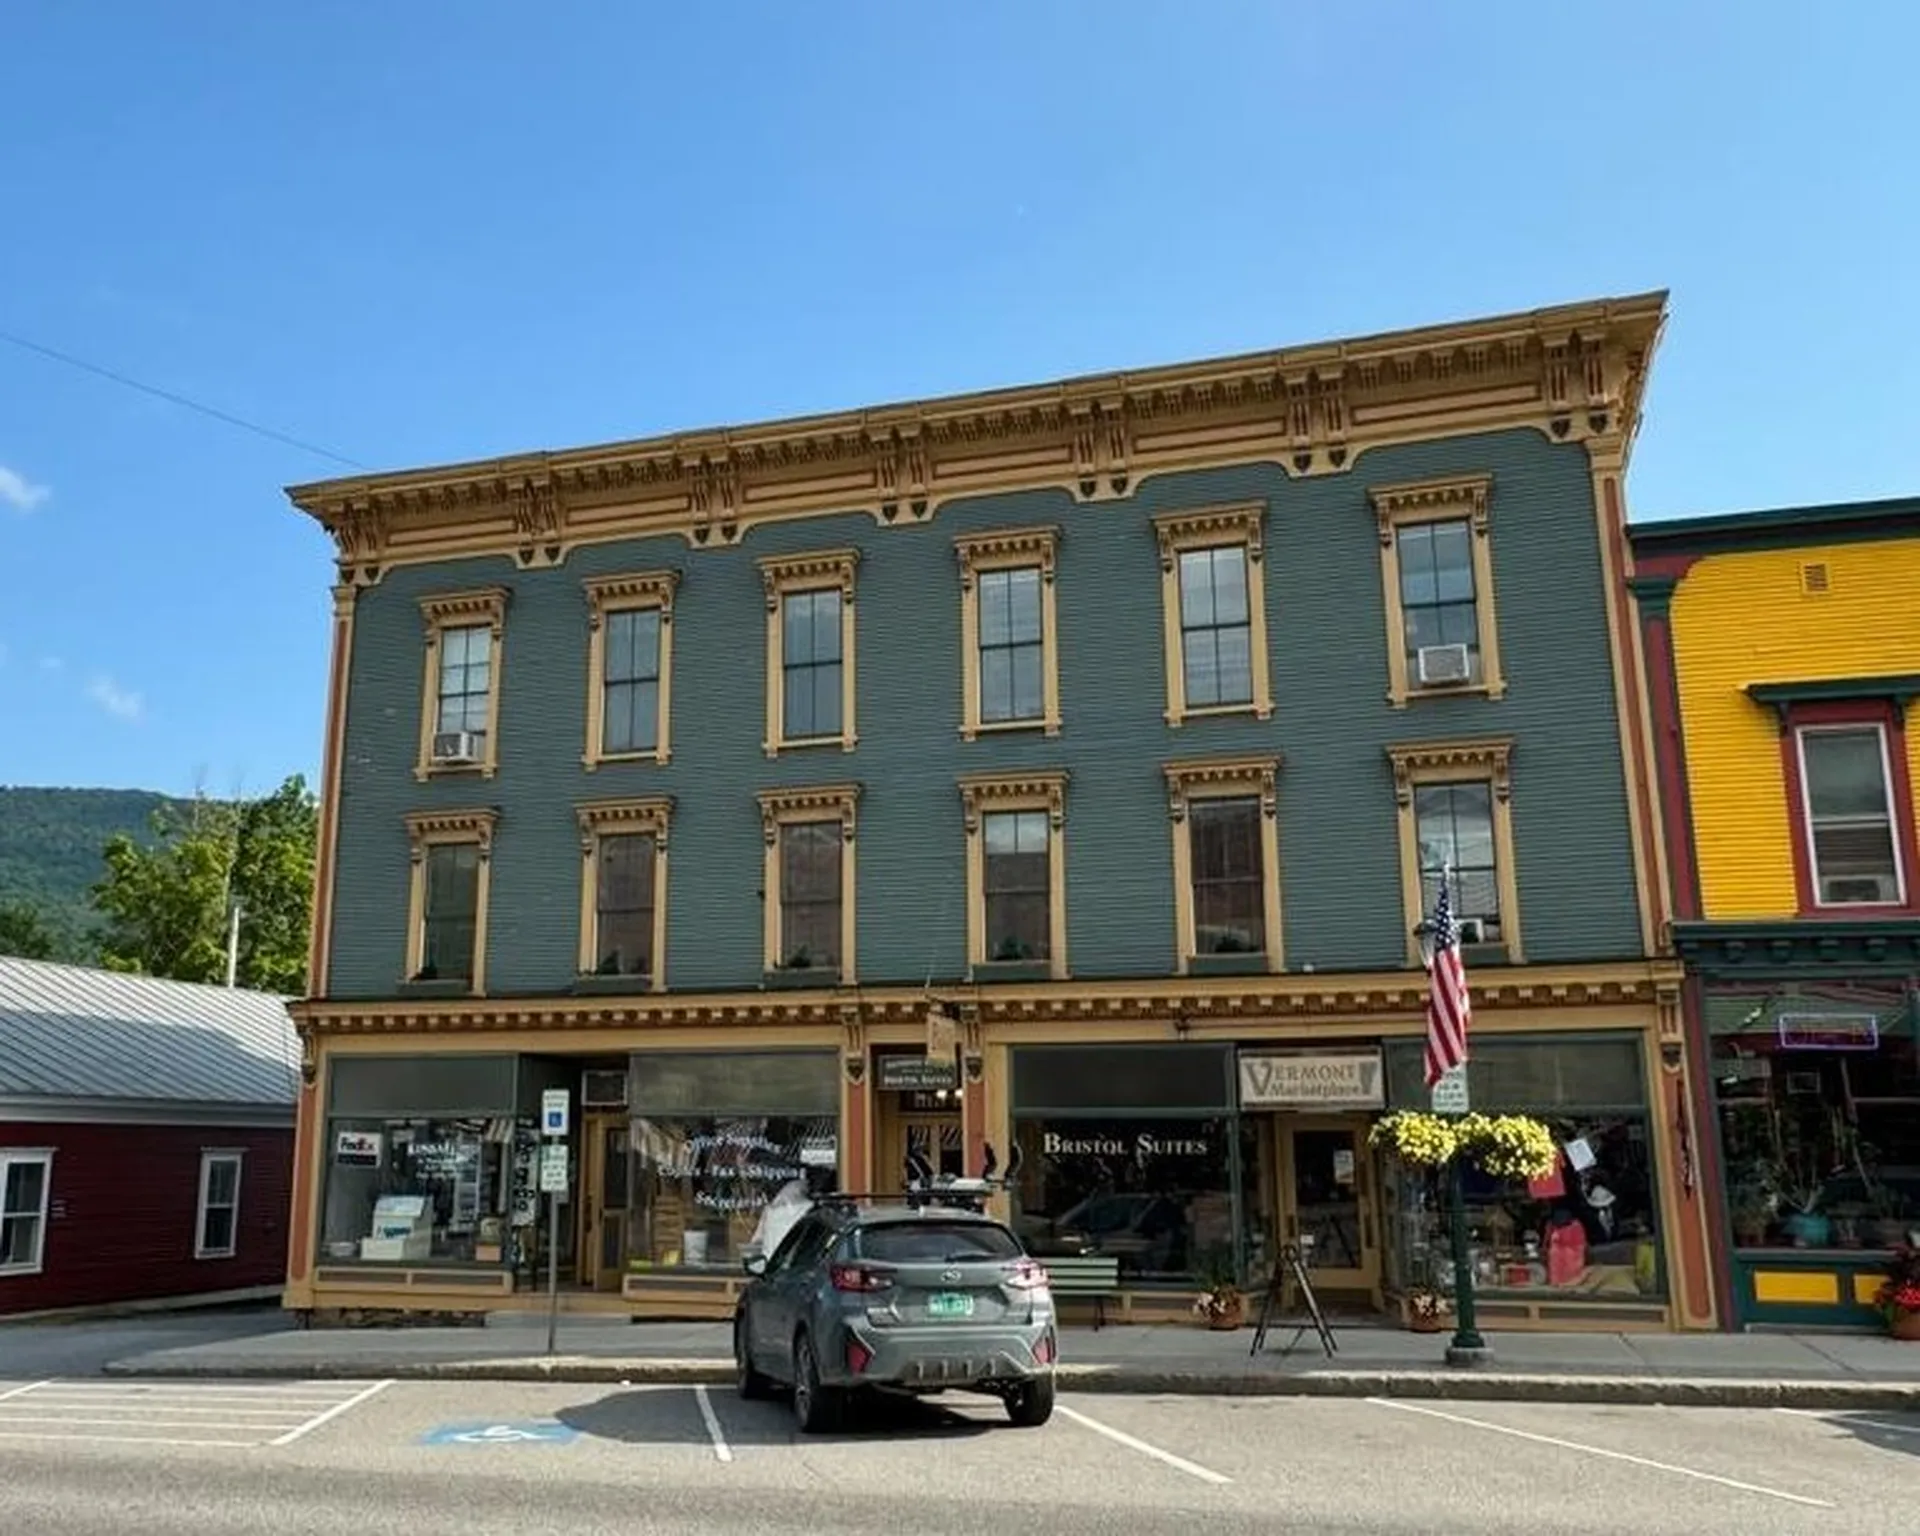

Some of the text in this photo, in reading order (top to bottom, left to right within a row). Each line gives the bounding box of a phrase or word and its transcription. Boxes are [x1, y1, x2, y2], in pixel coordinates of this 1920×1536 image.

[1244, 1060, 1356, 1096] VERMONT
[340, 1136, 375, 1150] FedEx
[1043, 1132, 1208, 1155] BRISTOL SUITES
